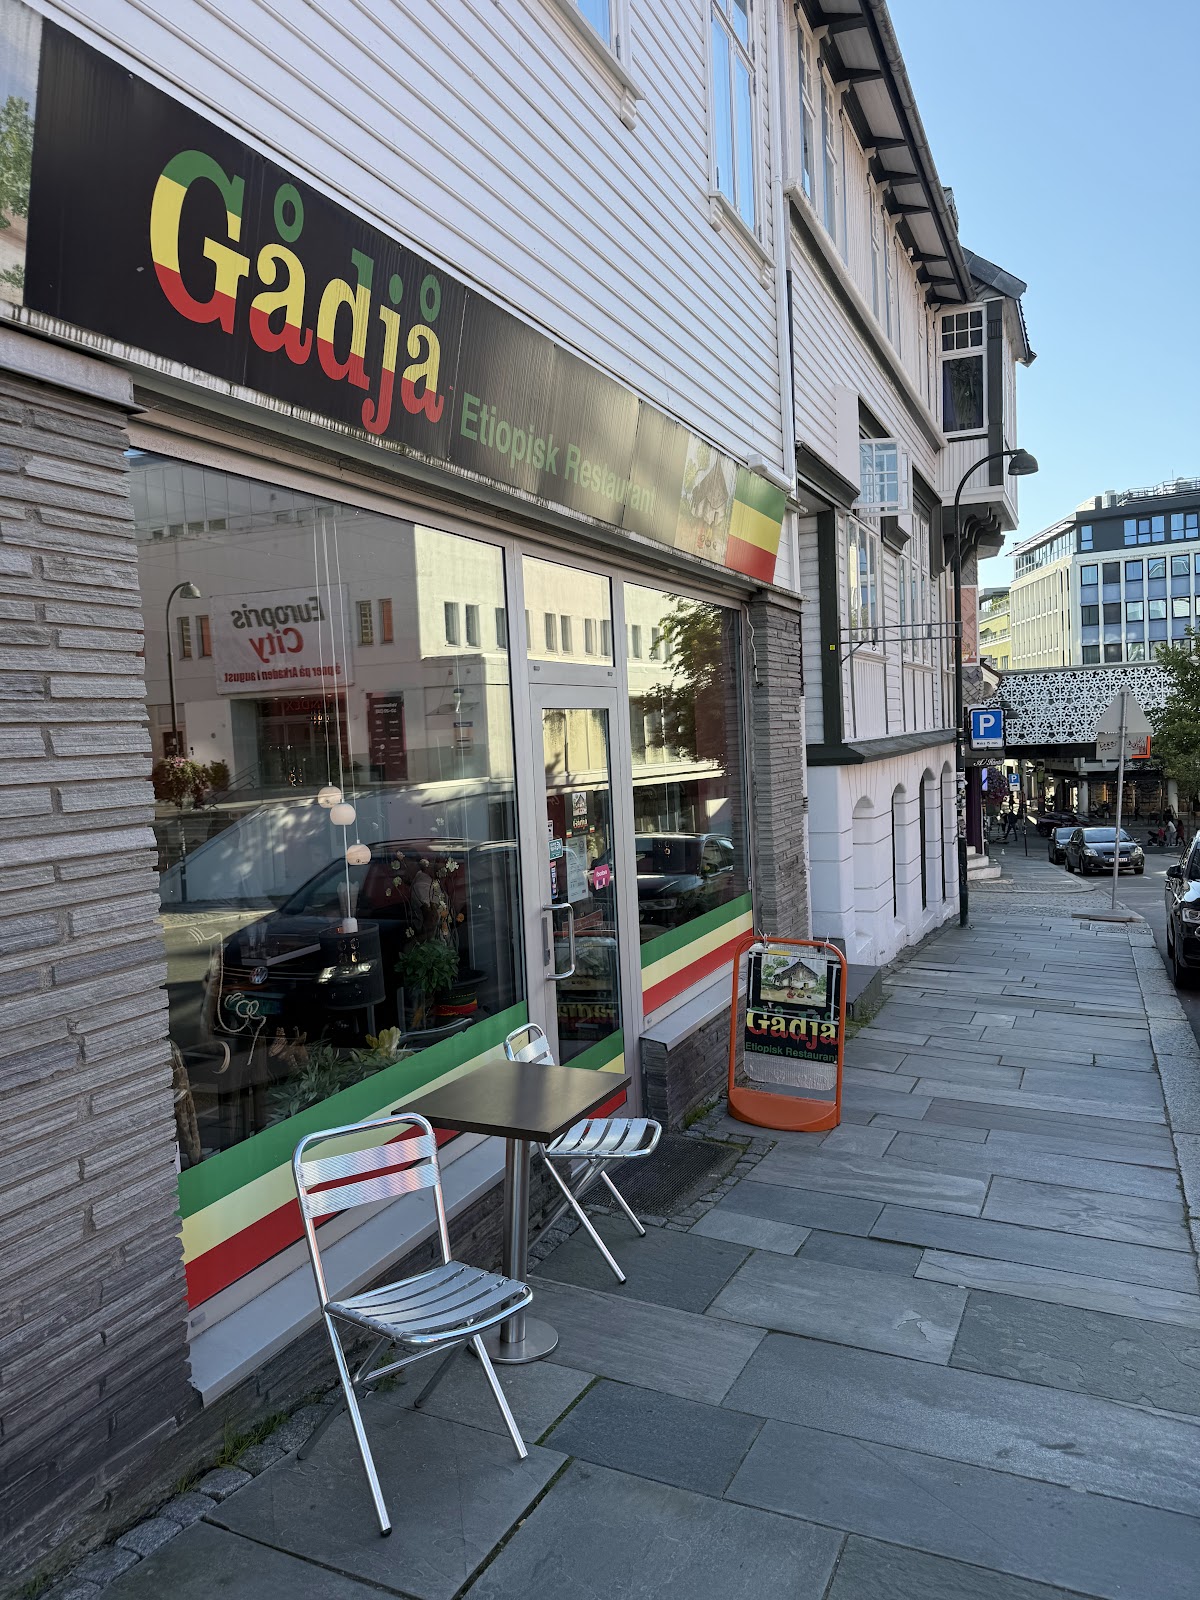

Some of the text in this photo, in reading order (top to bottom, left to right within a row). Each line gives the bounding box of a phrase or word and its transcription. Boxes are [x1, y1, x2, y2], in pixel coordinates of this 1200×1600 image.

[150, 150, 444, 434] Gådjå
[460, 391, 658, 518] Etiopisk Restaurant
[979, 714, 996, 736] P
[1011, 774, 1018, 783] P
[746, 1004, 839, 1050] Gådjå
[745, 1041, 784, 1056] Etiopisk
